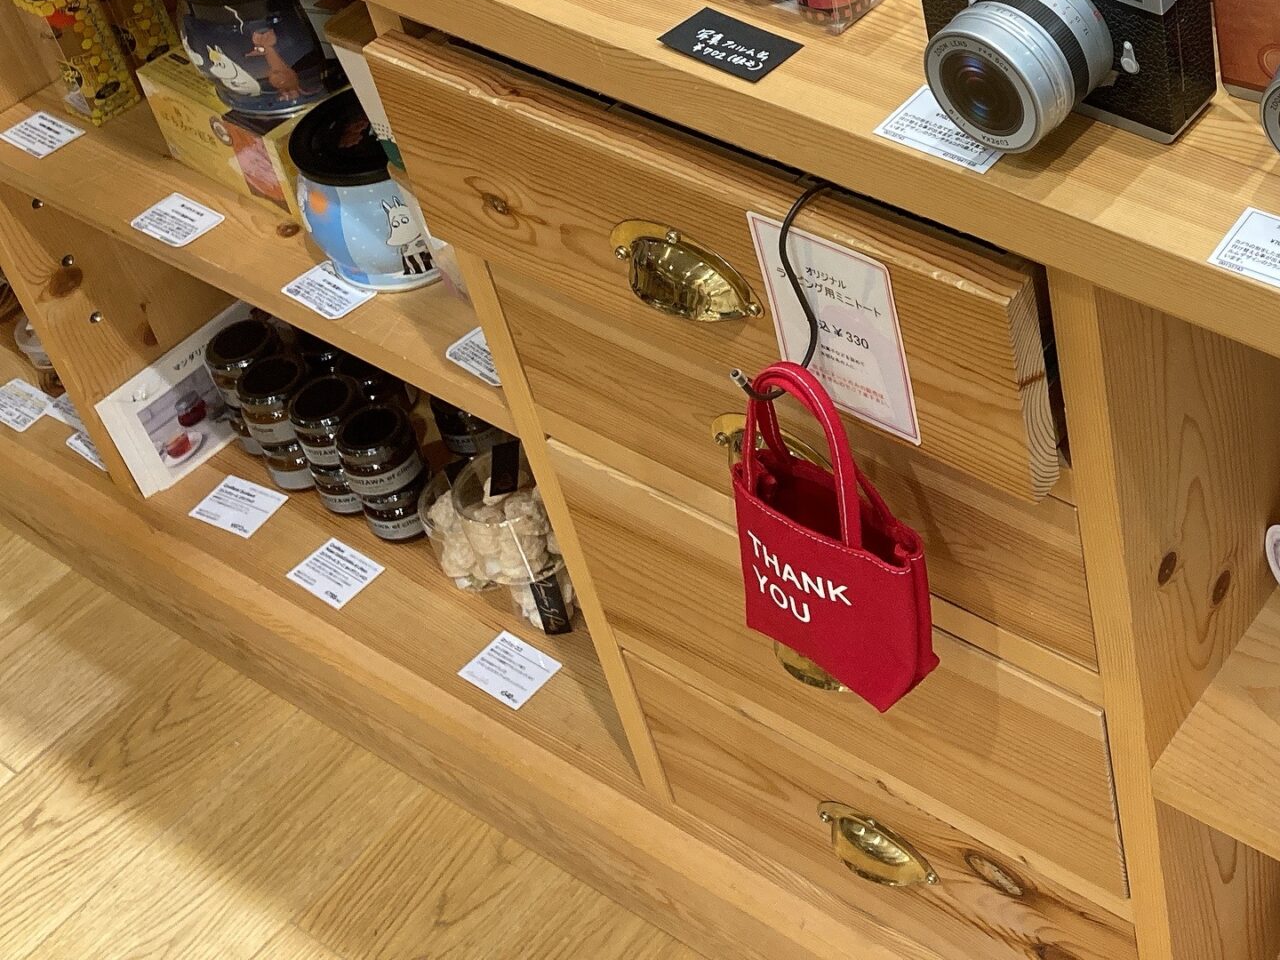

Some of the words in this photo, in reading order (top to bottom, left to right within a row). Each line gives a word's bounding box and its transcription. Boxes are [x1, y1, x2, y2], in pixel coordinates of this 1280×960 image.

[804, 266, 848, 290] オリジナル
[747, 529, 853, 607] THANK
[752, 563, 811, 623] YOU
